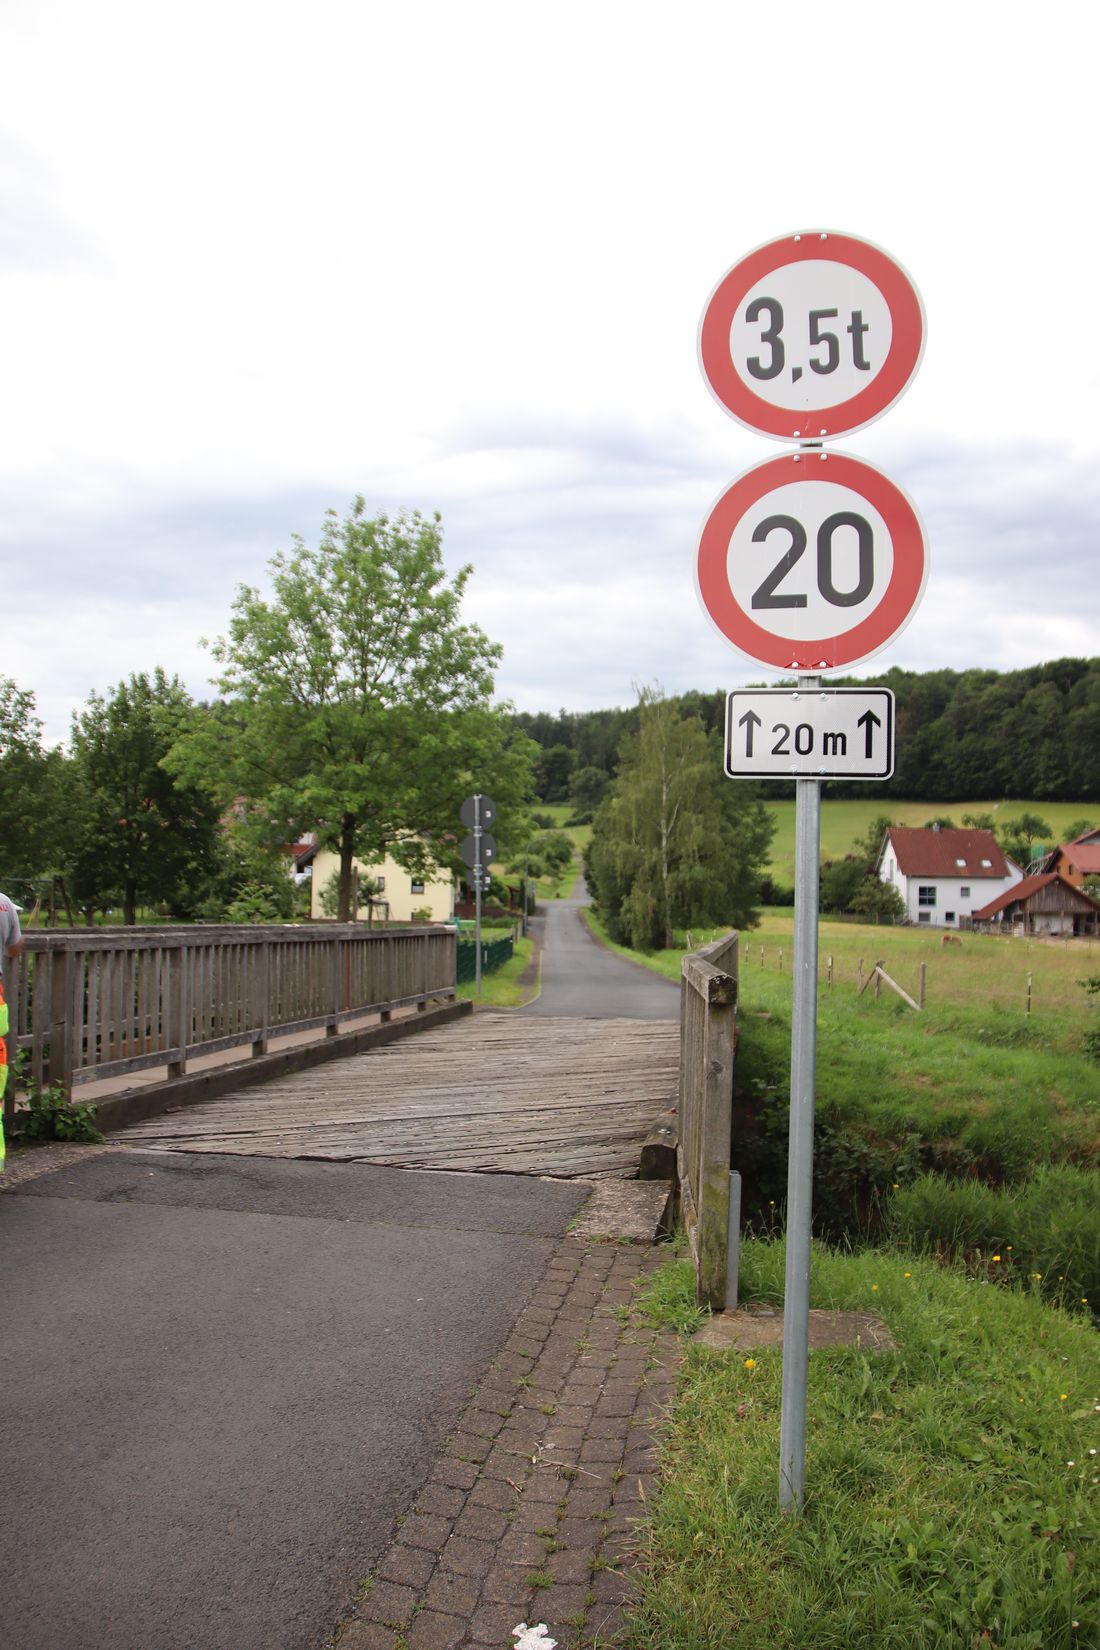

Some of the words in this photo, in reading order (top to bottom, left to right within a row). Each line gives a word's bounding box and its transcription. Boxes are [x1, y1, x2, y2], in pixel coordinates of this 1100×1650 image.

[745, 296, 871, 384] 3,5t
[751, 511, 874, 610] 20
[771, 723, 814, 756] 20
[822, 732, 847, 756] m
